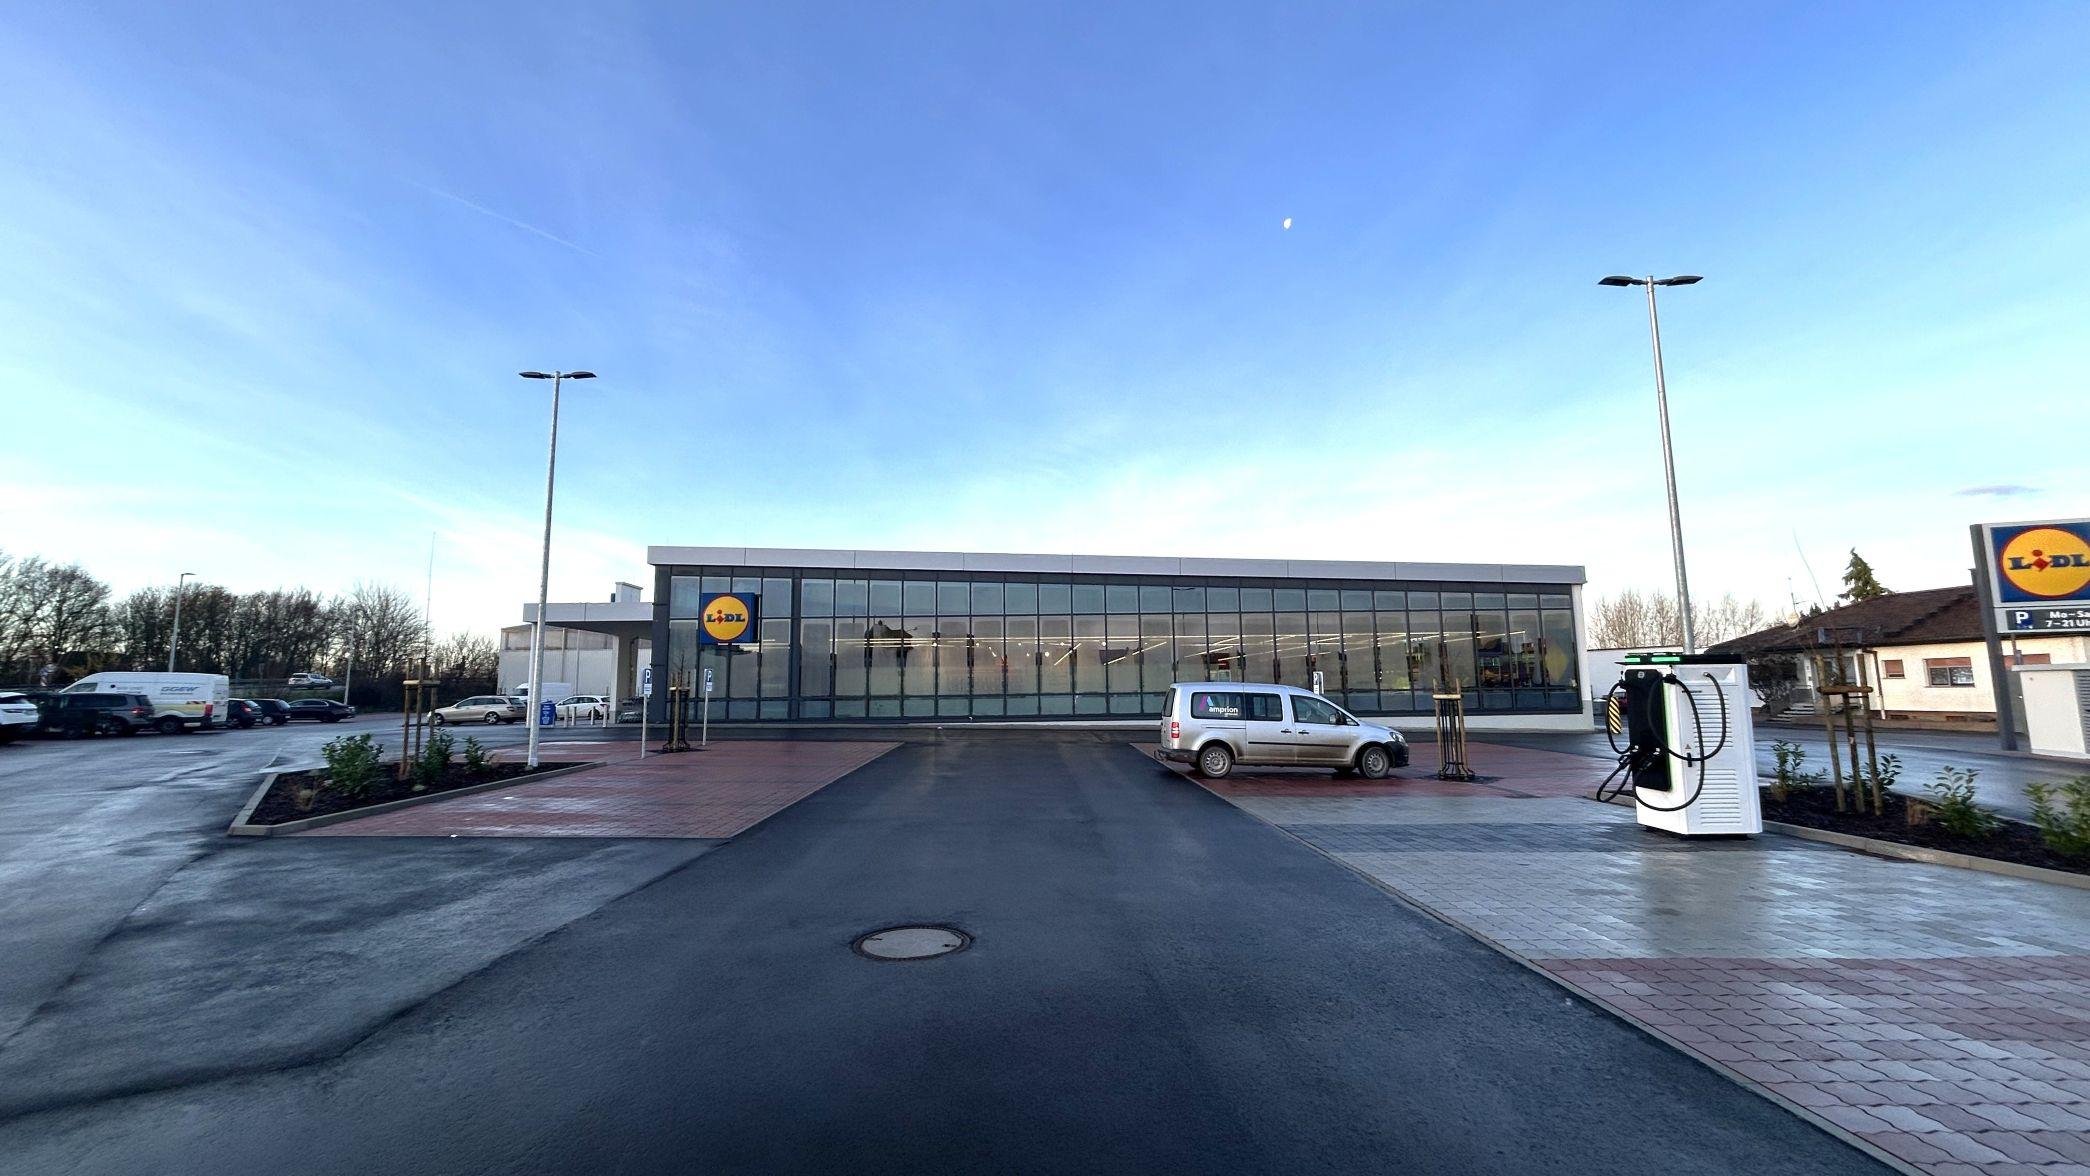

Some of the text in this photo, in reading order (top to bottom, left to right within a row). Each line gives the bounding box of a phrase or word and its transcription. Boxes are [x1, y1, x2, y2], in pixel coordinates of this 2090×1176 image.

[2015, 611, 2029, 624] P
[645, 669, 651, 683] P
[1208, 705, 1238, 714] amprion
